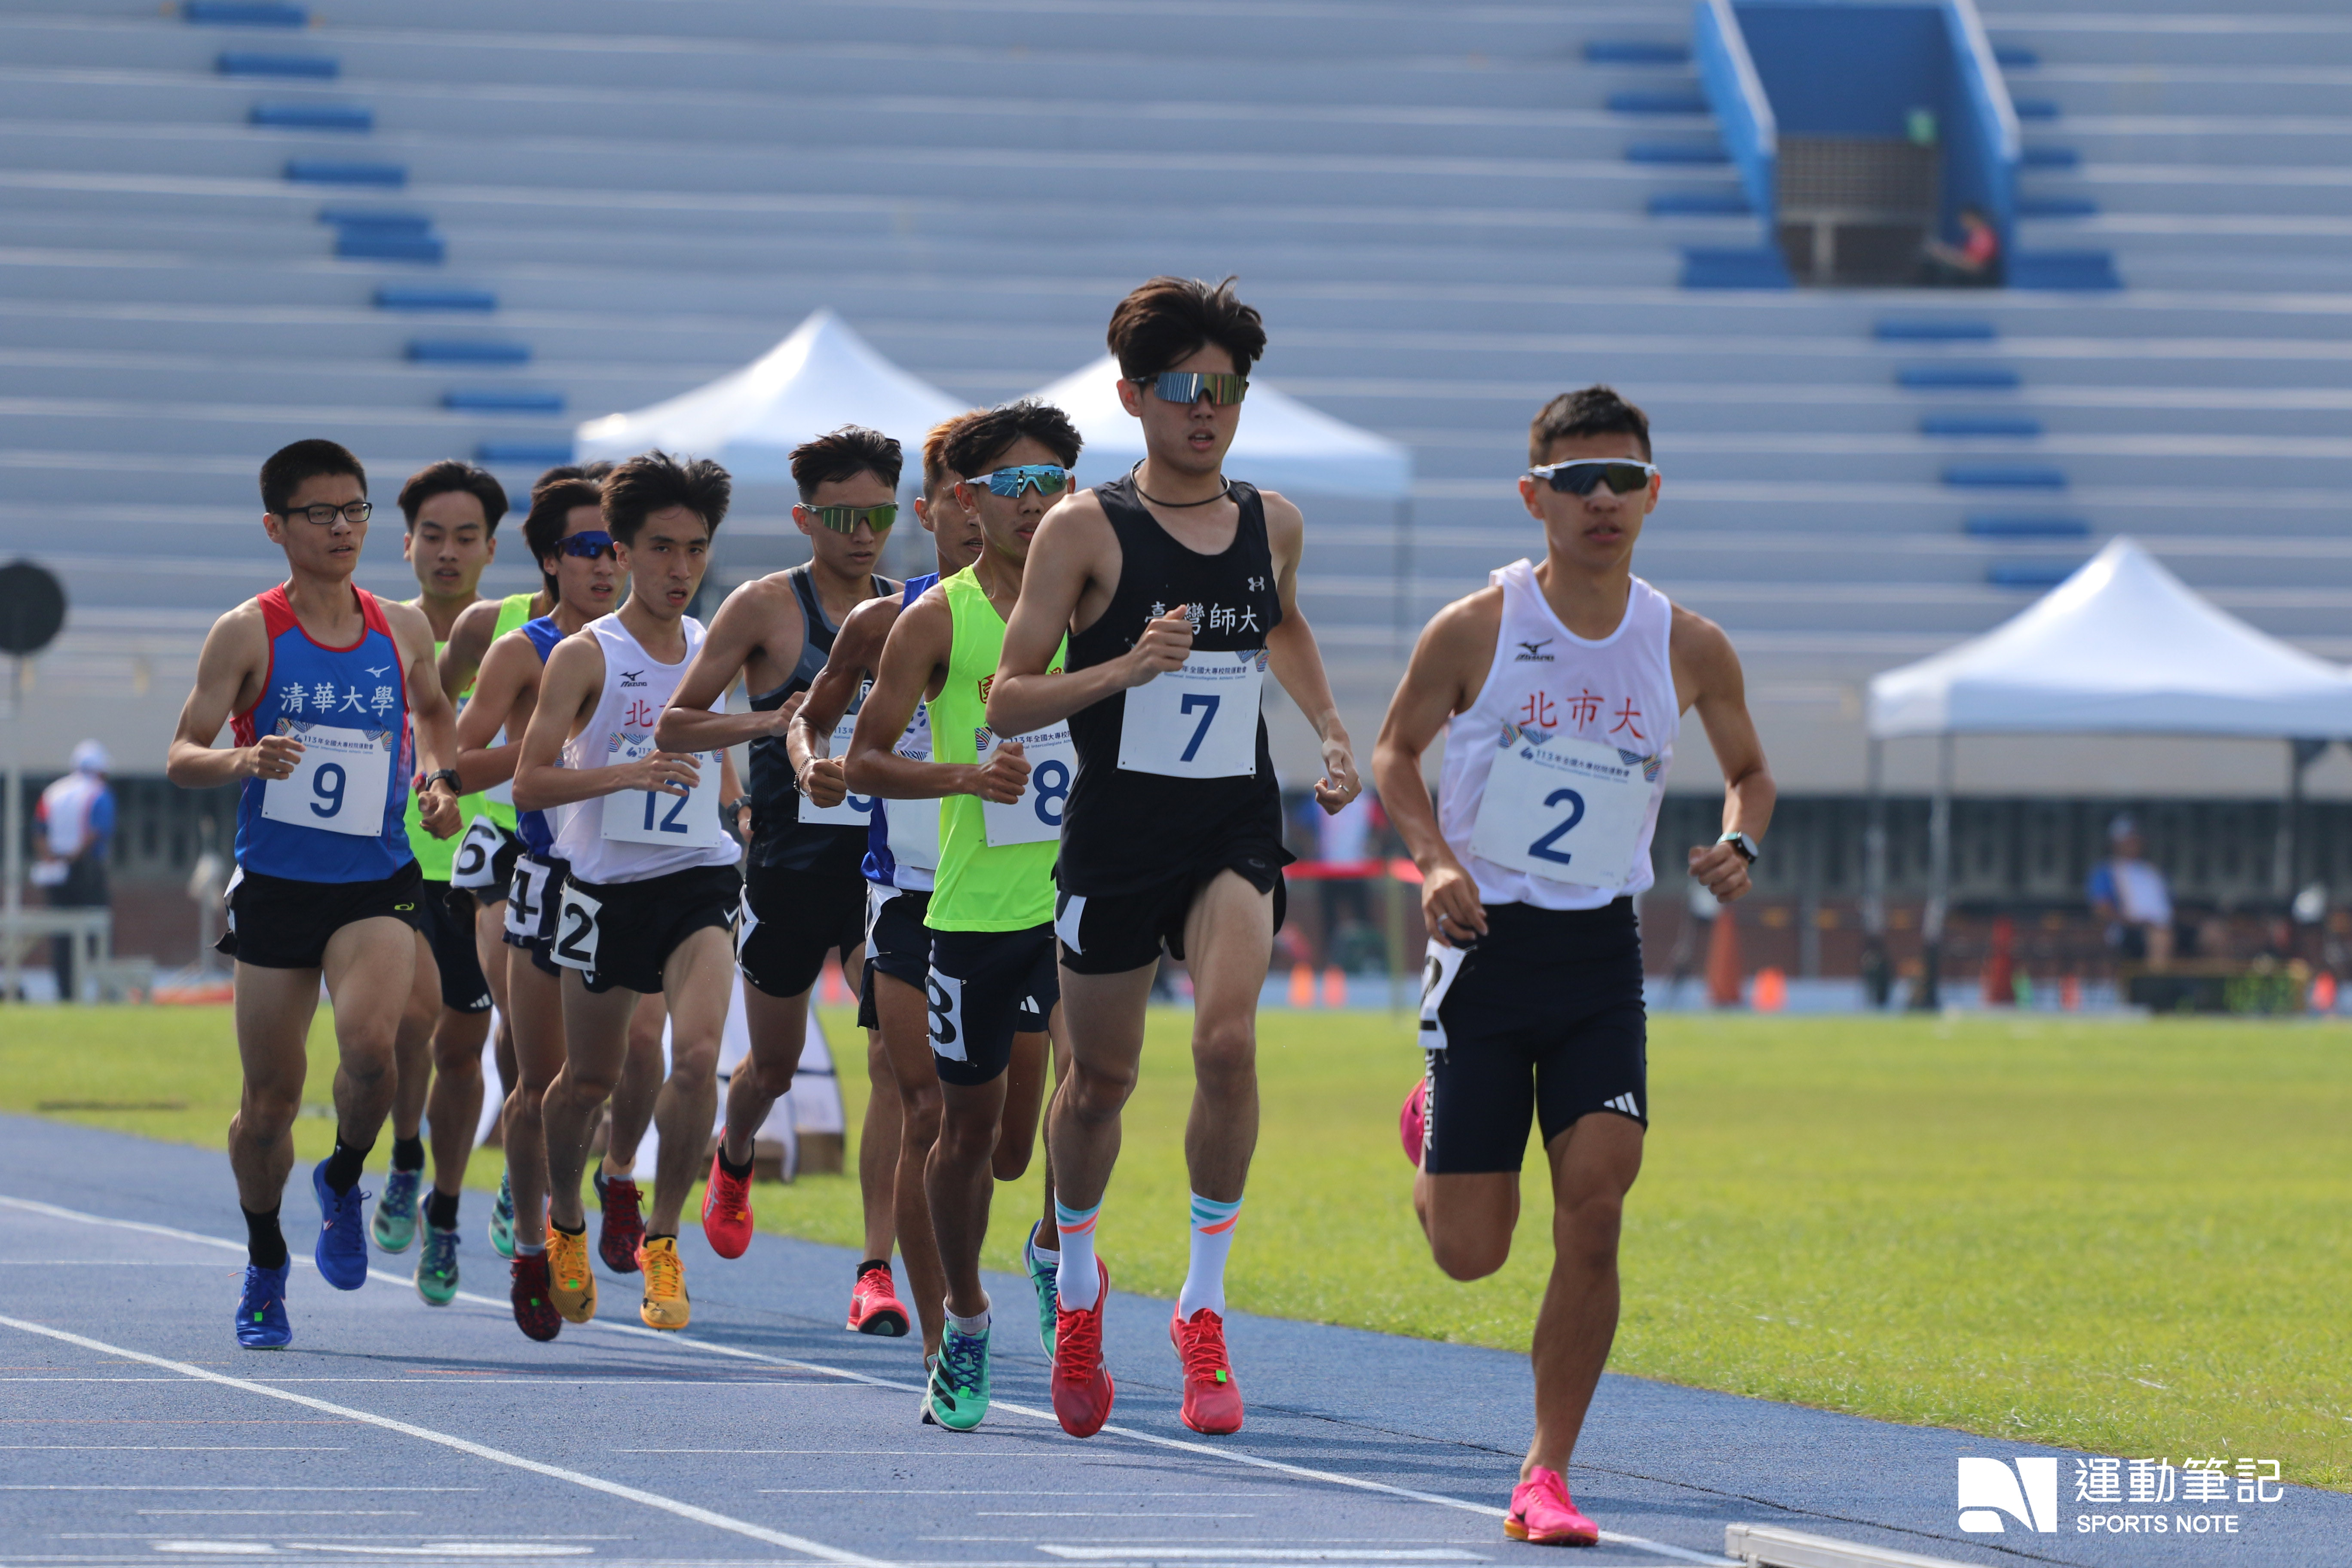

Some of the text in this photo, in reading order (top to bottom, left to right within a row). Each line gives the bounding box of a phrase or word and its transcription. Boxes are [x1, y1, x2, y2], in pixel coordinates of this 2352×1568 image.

[280, 682, 394, 717] 清華大學
[1519, 689, 1645, 739] 北市大
[1180, 694, 1220, 761] 7
[310, 763, 346, 818] 9
[644, 779, 689, 833] 12
[1033, 760, 1070, 826] 8
[456, 824, 496, 876] 6
[1528, 788, 1585, 865] 2
[508, 869, 538, 925] 4
[926, 974, 956, 1044] 8
